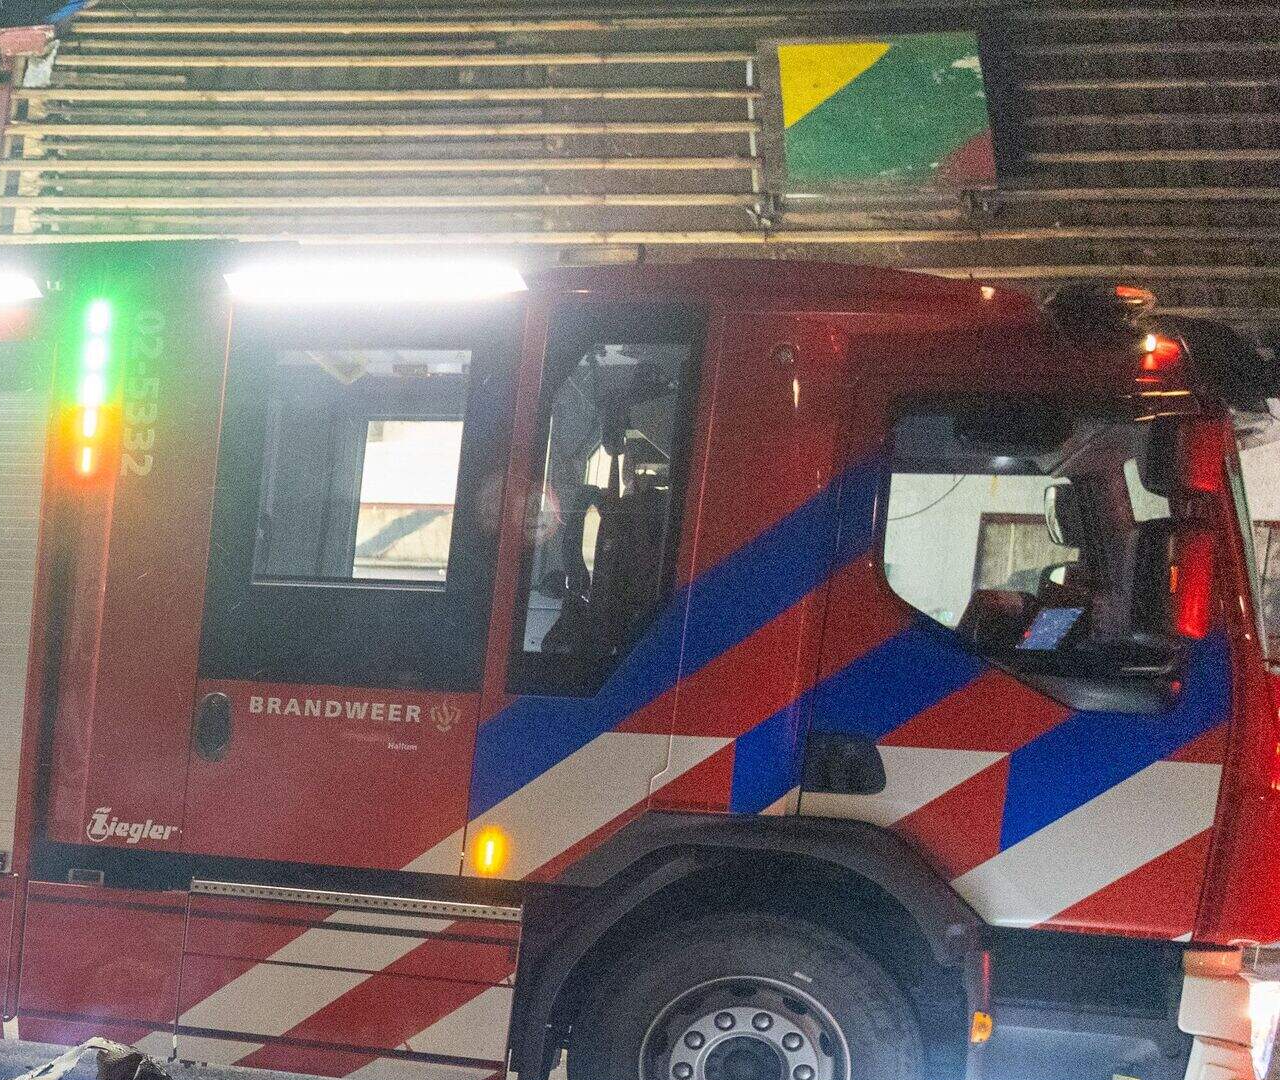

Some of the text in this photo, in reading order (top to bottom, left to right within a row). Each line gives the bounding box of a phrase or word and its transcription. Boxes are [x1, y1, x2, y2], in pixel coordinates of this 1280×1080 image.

[119, 310, 165, 477] 02-5332
[248, 696, 422, 723] BRANDWEER
[86, 806, 179, 844] Ziegler
